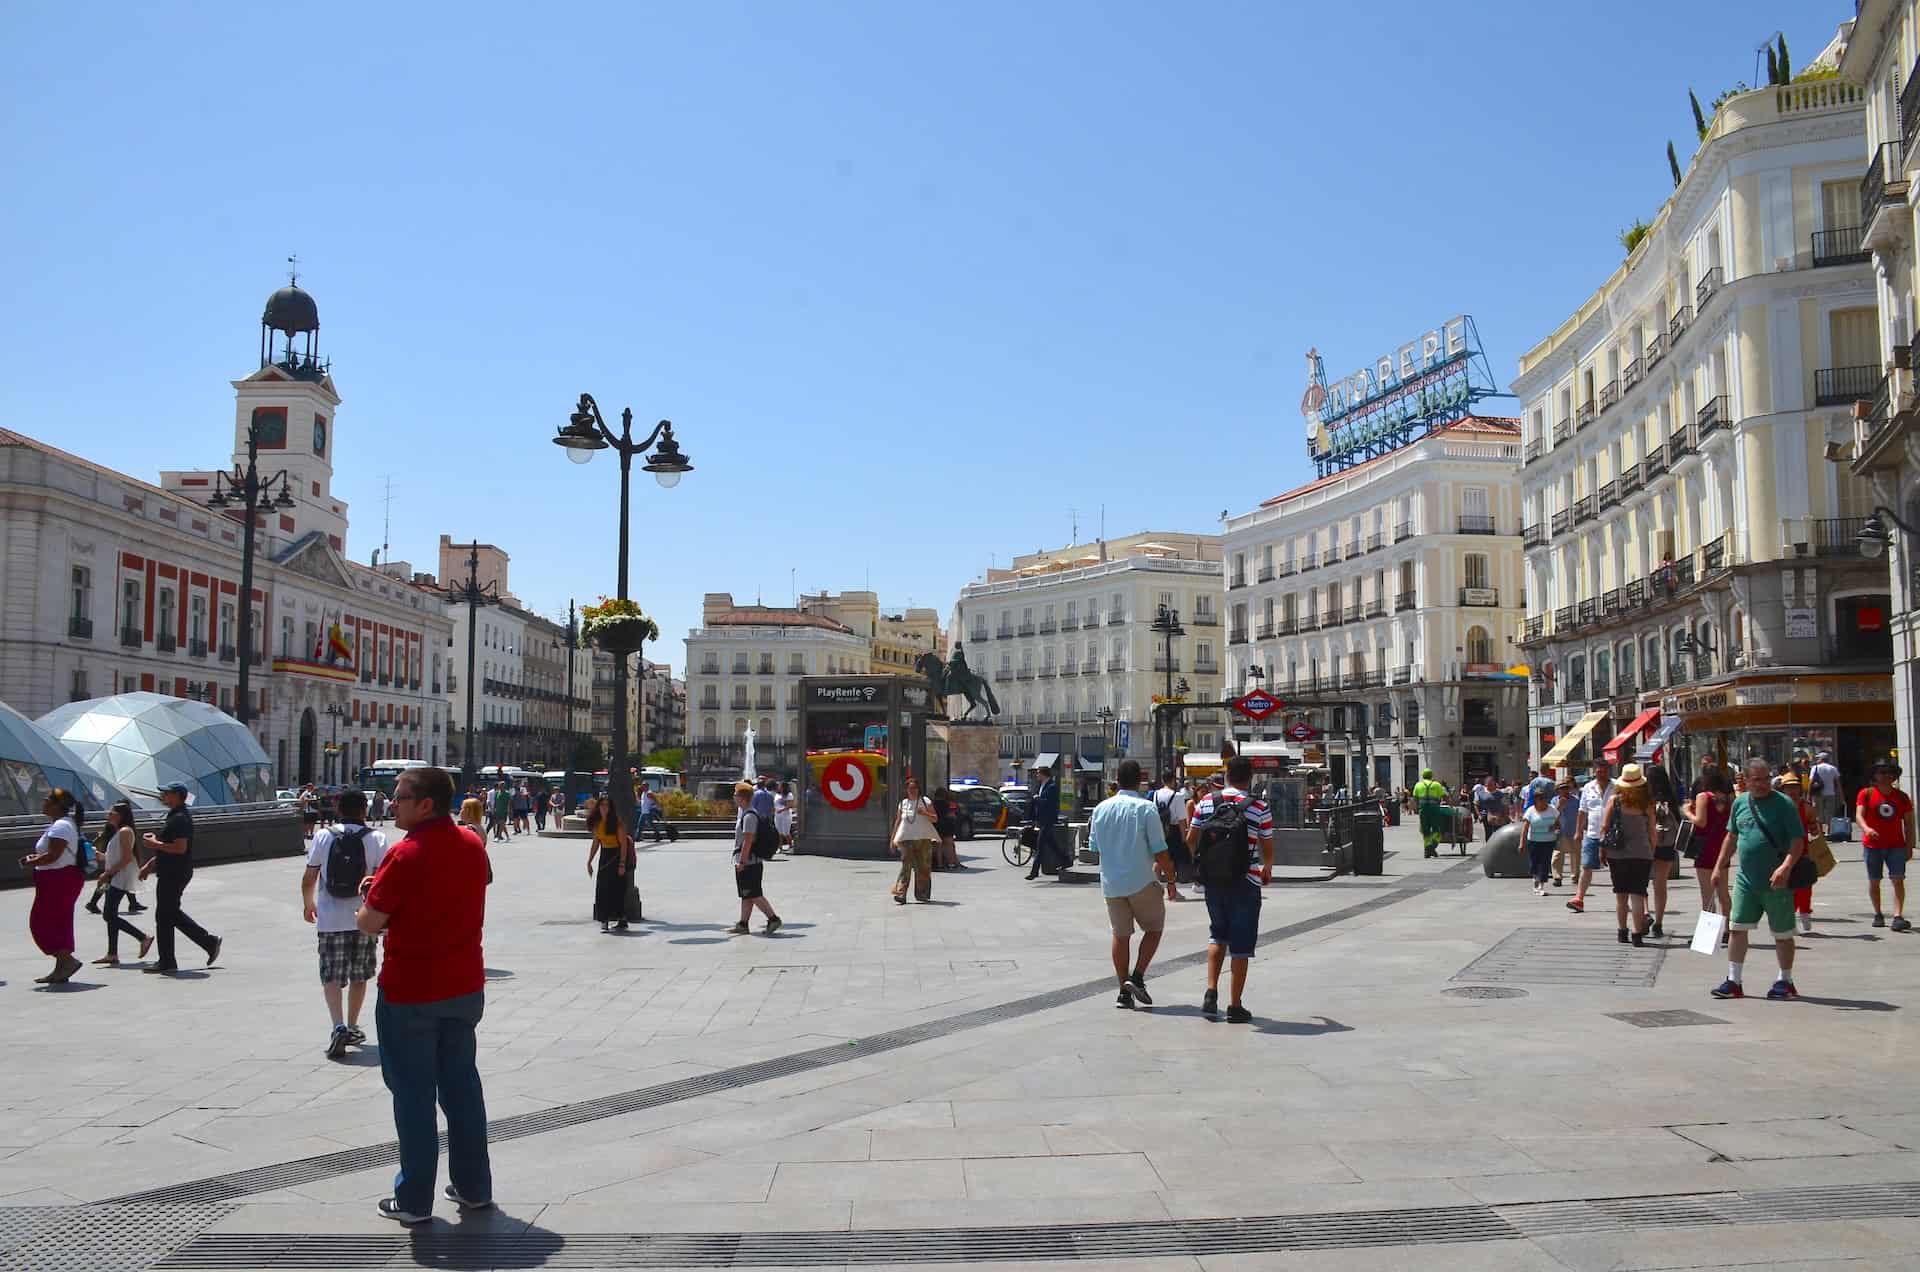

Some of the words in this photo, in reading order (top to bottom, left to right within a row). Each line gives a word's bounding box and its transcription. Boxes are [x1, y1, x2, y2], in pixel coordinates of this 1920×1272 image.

[1328, 368, 1368, 412] TIO
[1376, 314, 1465, 392] PEPE
[817, 687, 861, 698] PlayRenfe
[1246, 700, 1270, 709] Metro
[1120, 723, 1128, 744] P
